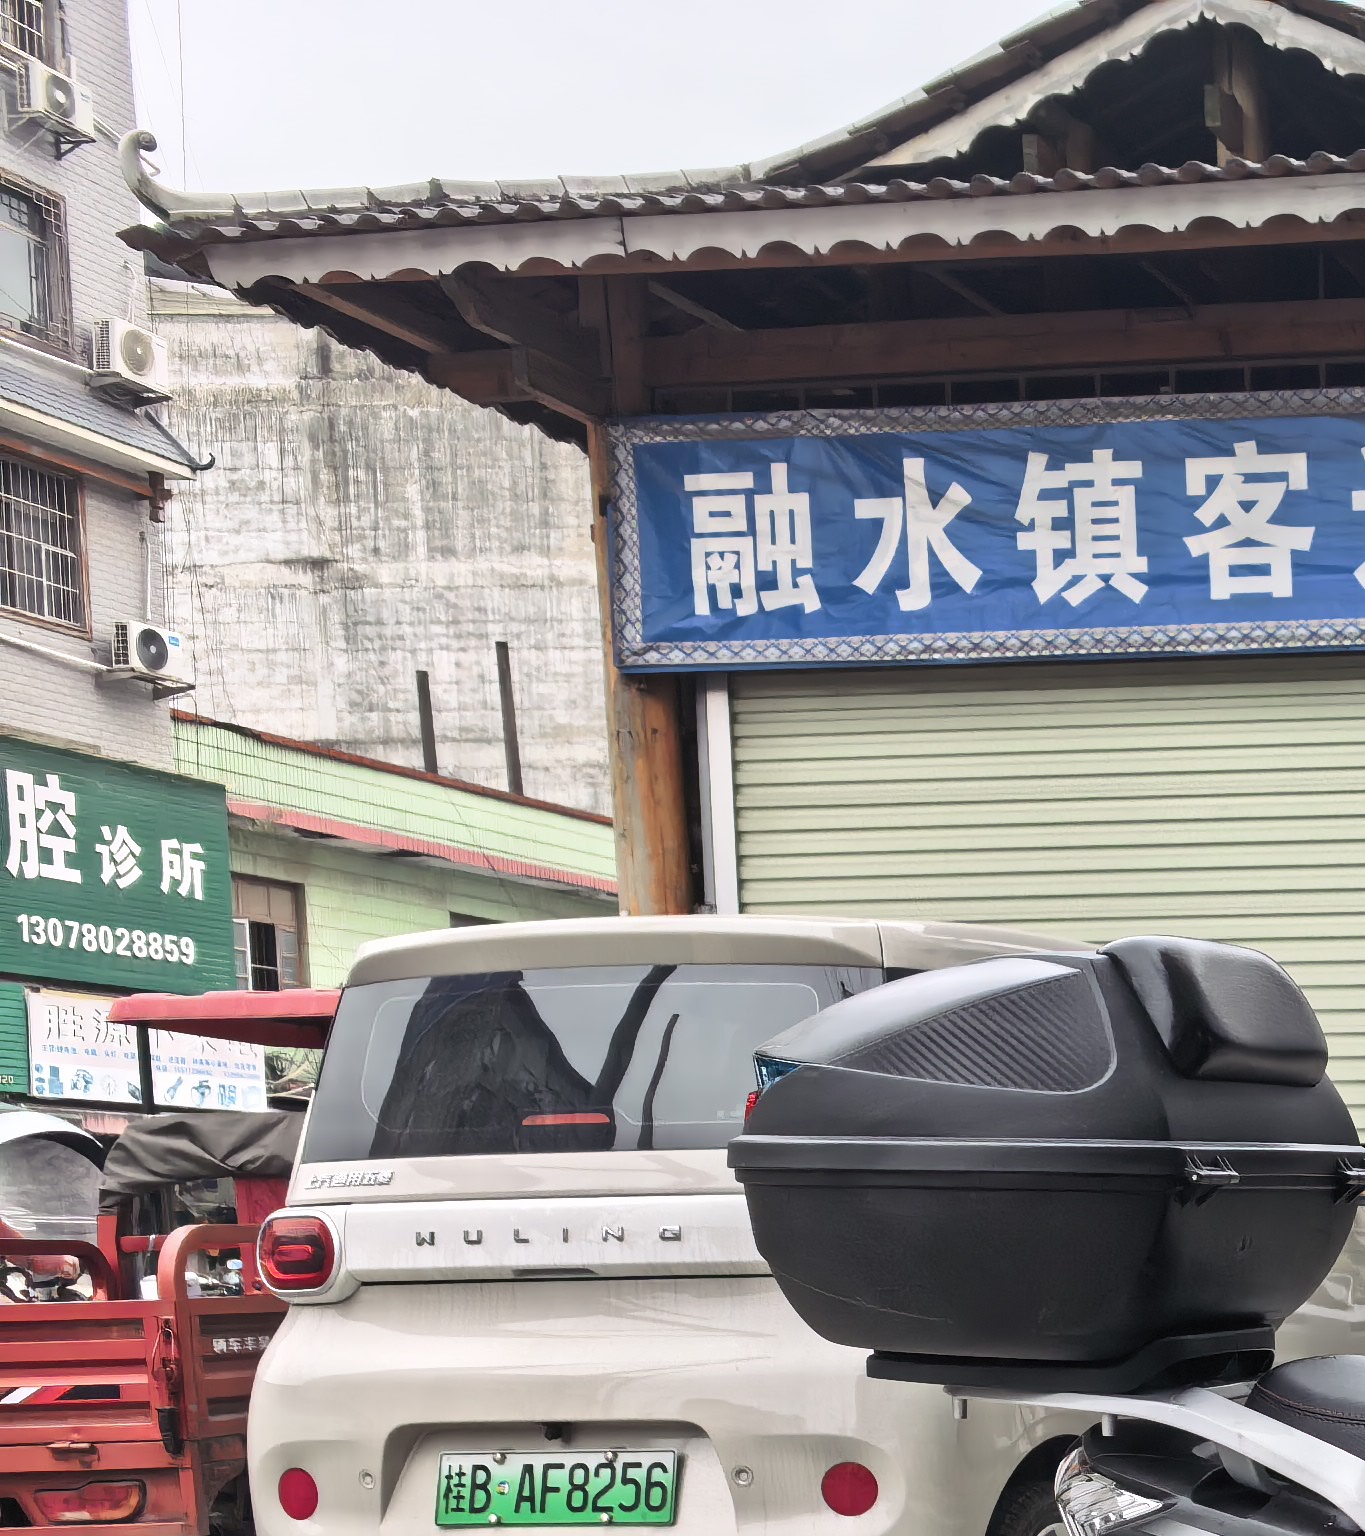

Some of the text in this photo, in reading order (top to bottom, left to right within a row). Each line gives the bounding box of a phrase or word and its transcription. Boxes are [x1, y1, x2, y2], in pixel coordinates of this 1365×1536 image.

[5, 769, 206, 901] 腔诊所
[16, 913, 196, 965] 13078028859
[415, 1224, 681, 1247] WULING
